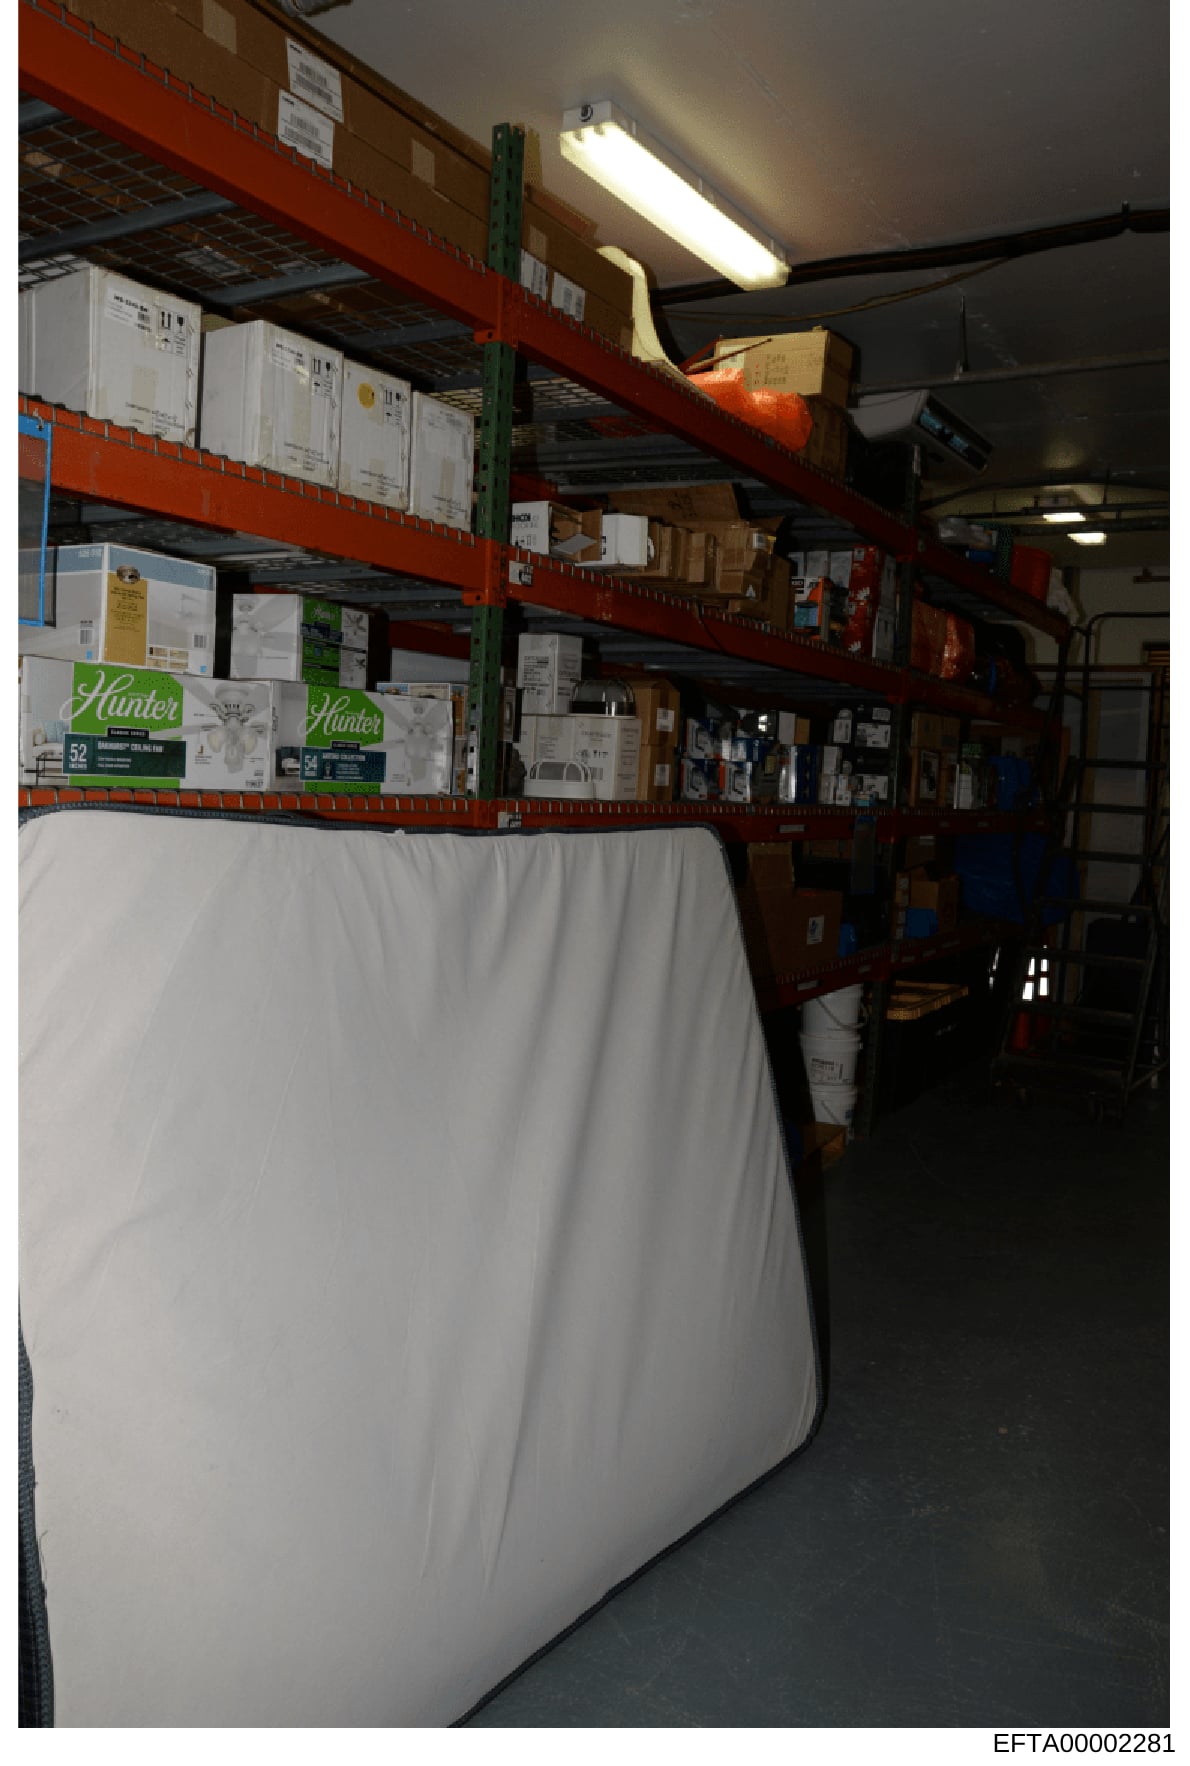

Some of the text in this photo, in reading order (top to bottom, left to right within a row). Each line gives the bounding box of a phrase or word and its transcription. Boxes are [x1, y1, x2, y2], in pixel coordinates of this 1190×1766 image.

[59, 670, 178, 721] Hunter
[297, 692, 381, 736] Hunter
[70, 743, 87, 762] 52
[304, 755, 318, 770] 54
